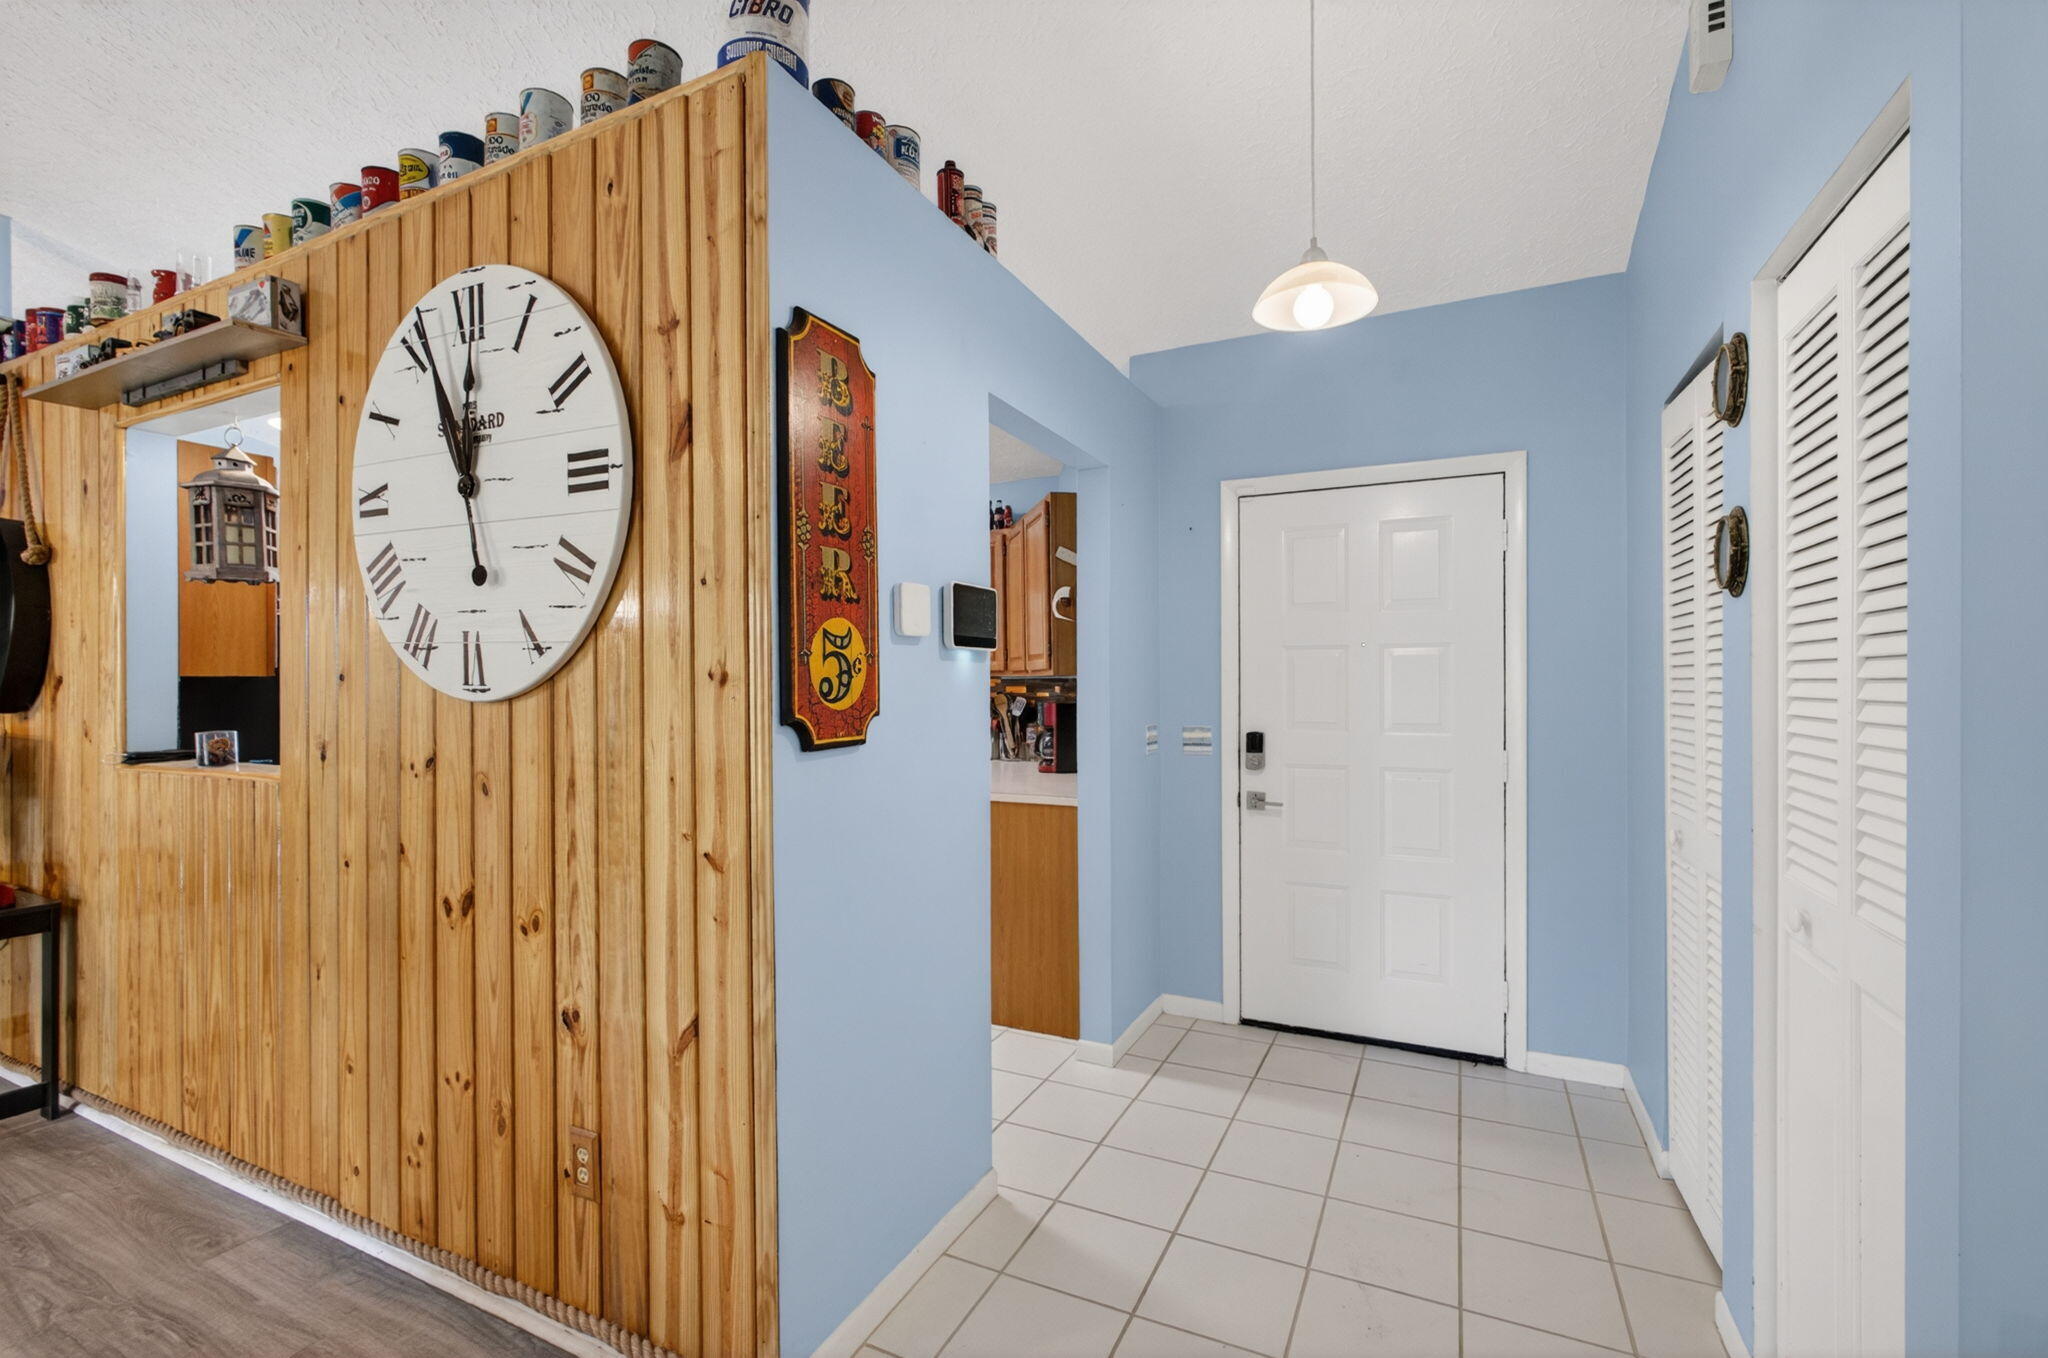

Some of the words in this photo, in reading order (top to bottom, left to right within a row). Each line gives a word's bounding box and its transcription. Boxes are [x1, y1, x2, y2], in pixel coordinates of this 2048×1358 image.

[451, 282, 486, 347] XII
[549, 351, 592, 408] II
[368, 401, 400, 440] X
[567, 448, 609, 496] III
[815, 347, 860, 604] BEER
